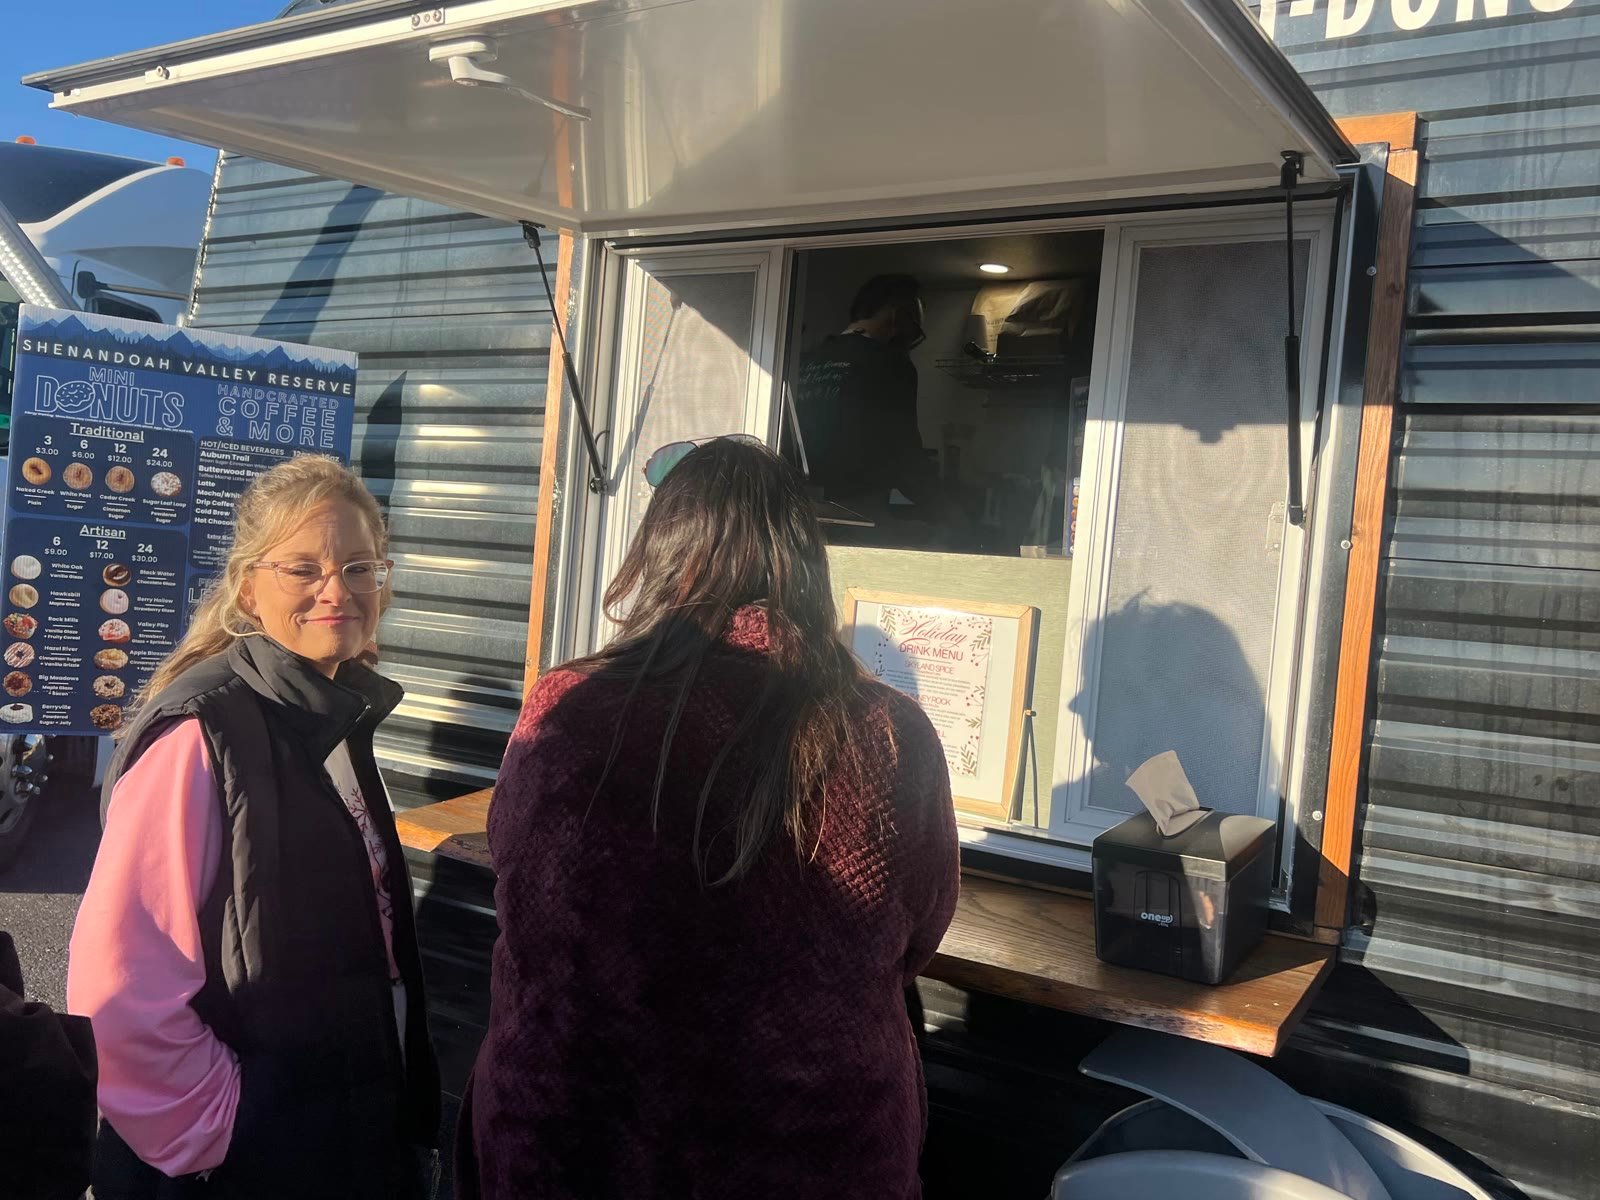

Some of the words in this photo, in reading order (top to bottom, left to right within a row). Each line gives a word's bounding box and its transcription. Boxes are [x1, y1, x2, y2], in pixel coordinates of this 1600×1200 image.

[22, 339, 170, 370] SHENANDOAH
[183, 361, 256, 381] VALLEY
[268, 373, 351, 395] RESERVE
[89, 367, 135, 386] MINI
[217, 384, 339, 409] HANDCRAFTED
[218, 396, 336, 429] COFFEE
[70, 422, 144, 442] Traditional
[216, 416, 233, 436] &
[249, 420, 334, 448] MORE
[44, 436, 52, 445] 3
[80, 440, 88, 449] 6
[36, 447, 59, 456] $3.00
[114, 443, 126, 454] 12
[152, 448, 168, 458] 24
[200, 440, 240, 451] HOT/ICED
[240, 444, 285, 456] BEVERAGES
[72, 450, 95, 460] $6.00
[107, 454, 132, 464] $12.00
[200, 450, 230, 460] Auburn
[232, 454, 250, 462] Trail
[146, 458, 173, 468] $24.00
[198, 465, 246, 476] Butterwood
[197, 489, 242, 498] Mocha/Whit
[196, 498, 211, 506] Drip
[212, 500, 235, 508] Coffee
[80, 524, 126, 538] Artisan
[53, 536, 61, 546] 6
[96, 540, 109, 550] 12
[137, 544, 153, 554] 24
[90, 552, 114, 560] $17.00
[132, 555, 158, 563] $30.00
[900, 617, 967, 648] Holiday
[899, 643, 930, 656] DRINK
[932, 648, 964, 661] MENU
[935, 664, 954, 674] SPICE
